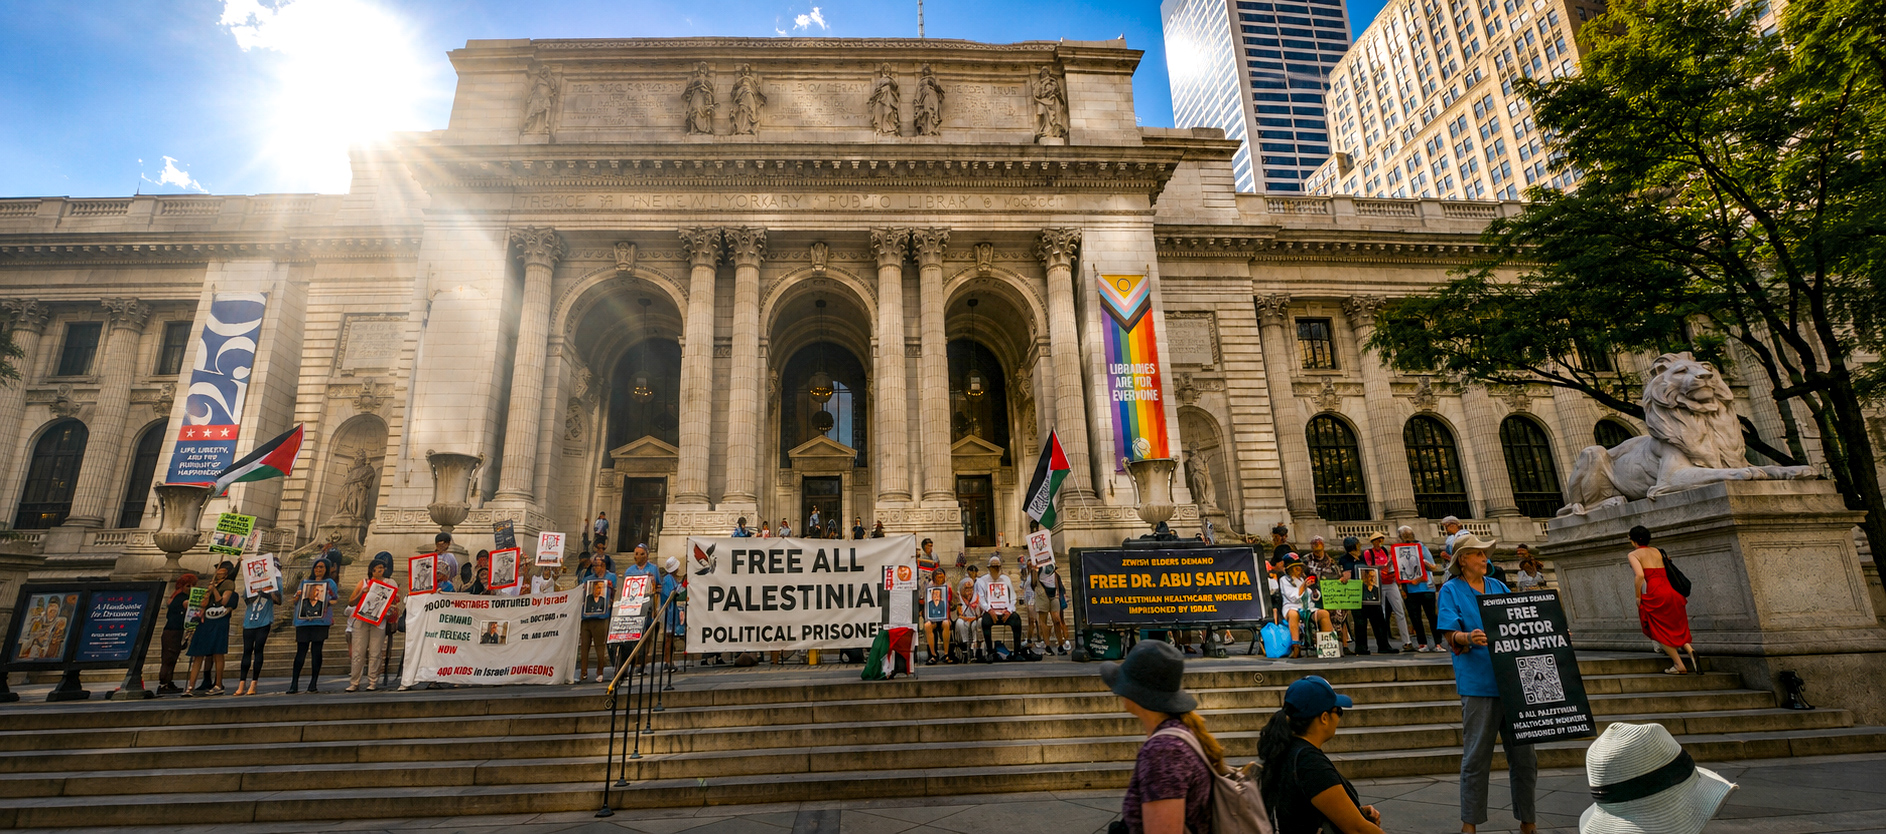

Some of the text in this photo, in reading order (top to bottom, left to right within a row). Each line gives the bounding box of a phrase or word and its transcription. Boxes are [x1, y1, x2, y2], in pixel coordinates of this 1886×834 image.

[1115, 376, 1133, 388] ARE
[1113, 389, 1159, 402] EVERYONE
[731, 547, 865, 575] FREE ALL
[1151, 558, 1179, 566] ELDERS
[1089, 570, 1251, 589] FREE DR. ABU SAFIYA
[491, 597, 531, 609] TORTURED
[531, 596, 541, 607] by
[1100, 596, 1113, 604] ALL
[1115, 595, 1163, 604] PALESTINIAN
[1164, 594, 1213, 603] HEALTHCARE
[1215, 592, 1253, 602] WORKERS
[1178, 605, 1188, 614] BY
[1506, 605, 1539, 620] FREE
[439, 629, 471, 641] RELEASE
[702, 622, 883, 644] POLITICAL PRISONE
[1498, 620, 1554, 637] DOCTOR
[437, 645, 458, 655] NOW
[1494, 634, 1568, 653] ABU SAFIYA
[437, 667, 452, 677] 400
[453, 666, 473, 676] KIDS
[473, 667, 482, 677] in
[510, 665, 555, 677] DUNGEONS
